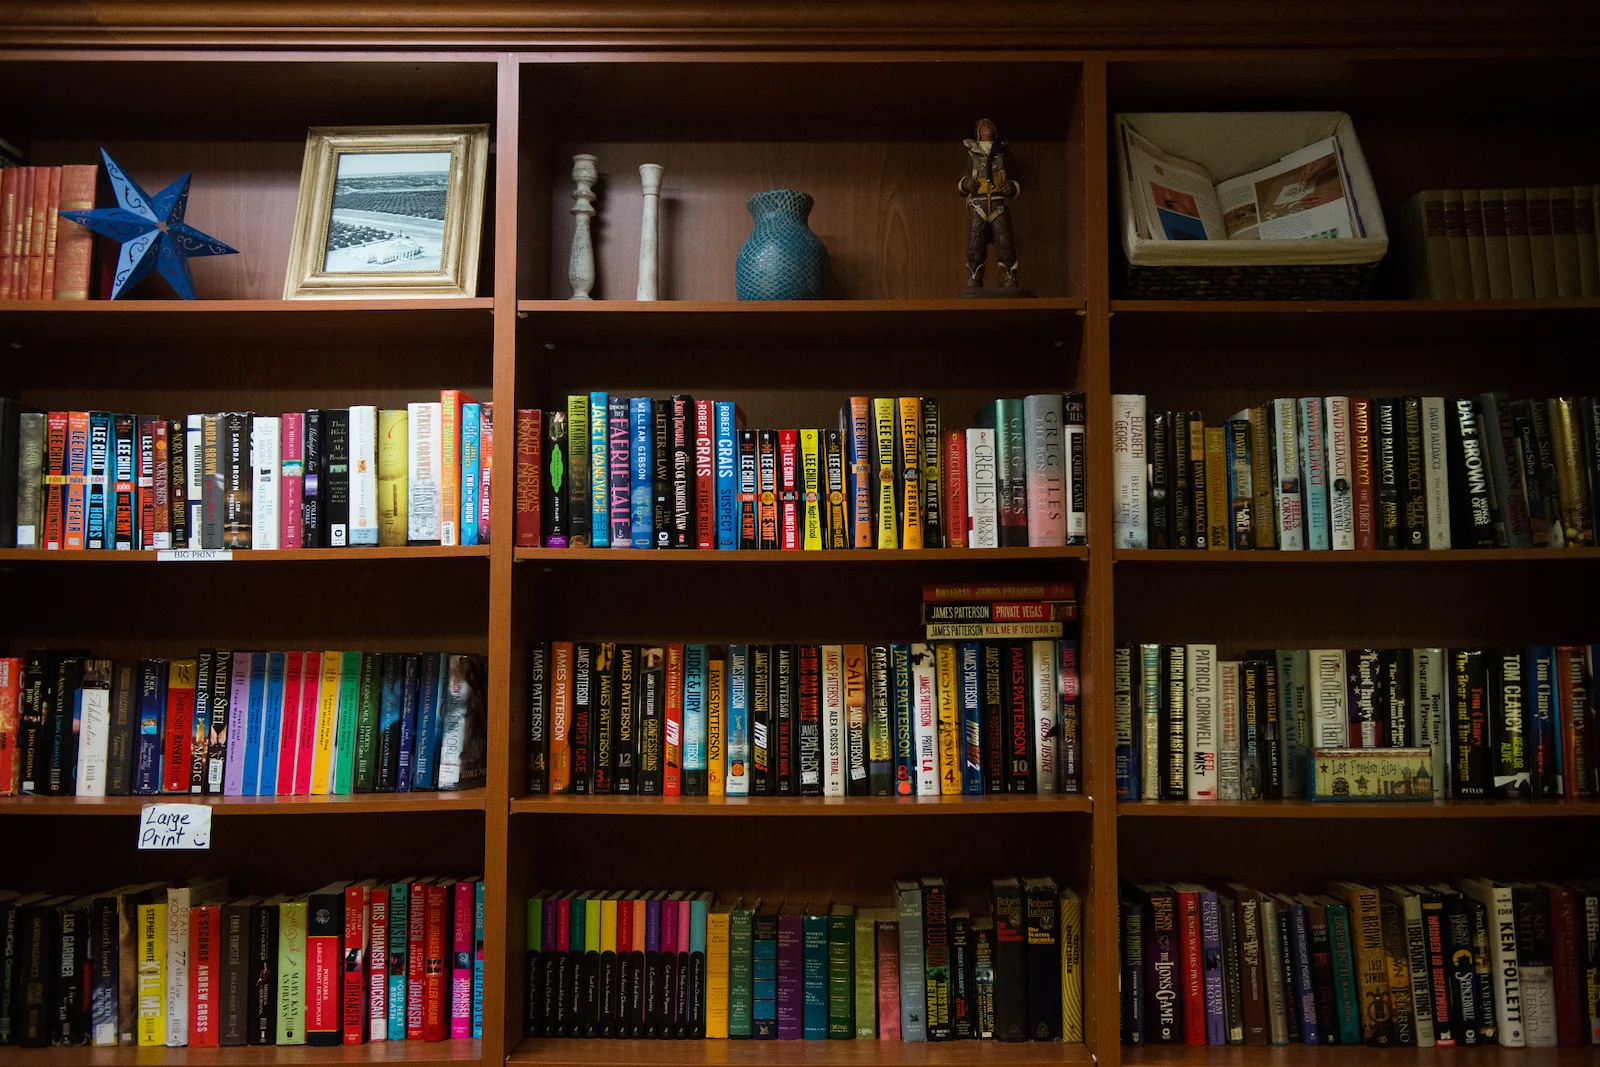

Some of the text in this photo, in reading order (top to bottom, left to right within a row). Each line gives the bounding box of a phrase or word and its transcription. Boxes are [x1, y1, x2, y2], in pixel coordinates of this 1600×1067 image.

[50, 430, 63, 470] LEE CHILD
[71, 431, 84, 471] LEE CHILD
[92, 427, 105, 469] LEE CHILD
[443, 396, 454, 468] JANET EVANOVICH
[697, 404, 710, 476] ROBERT CRAIS
[719, 406, 732, 477] ROBERT CRAIS
[856, 417, 867, 459] LEE CHILD
[880, 420, 892, 465] LEE CHILD
[905, 419, 916, 464] LEE CHILD
[1115, 420, 1128, 452] GEORGE
[1131, 417, 1143, 459] ELIZABETH
[1307, 401, 1322, 485] DAVID BALDACCI
[1333, 401, 1346, 476] DAVID BALDACCI
[1355, 402, 1369, 485] DAVID BALDACCI
[1380, 405, 1394, 484] DAVID BALDACCI
[1457, 401, 1486, 495] DALE BROWN
[117, 439, 130, 480] LEE CHILD
[592, 403, 606, 513] JANET EVANOVICH
[742, 455, 754, 492] LEE CHILD
[762, 454, 773, 490] LEE CHILD
[829, 454, 841, 490] LEE CHILD
[1045, 412, 1061, 520] GREG ILES
[156, 462, 167, 505] NORA ROBERTS
[927, 483, 938, 524] MAKE ME
[50, 486, 62, 540] WORTH DYING FOR
[69, 498, 82, 531] AFFAIR
[721, 489, 731, 532] SUSPECT
[1312, 491, 1324, 529] THE HIT
[1333, 497, 1343, 533] MAXWELL
[1381, 501, 1391, 528] JUSTICE
[1481, 498, 1491, 524] WINGS
[26, 689, 34, 704] JURY
[197, 654, 211, 715] DANIELLE STEEL
[213, 651, 230, 726] DANIELLE STEEL
[530, 649, 543, 741] JAMES PATTERSON
[554, 649, 566, 740] JAMES PATTERSON
[574, 646, 589, 705] JAMES PATTERSON
[621, 649, 632, 741] JAMES PATTERSON
[780, 649, 790, 718] JAMES PATTERSON
[800, 658, 818, 722] BIG BAD WOLF
[847, 658, 863, 697] SAIL
[964, 647, 977, 708] JAMES PATTERSON
[1115, 648, 1131, 747] PATRICIA CORNWELL
[1196, 650, 1211, 747] PATRICIA CORNWELL
[1503, 654, 1522, 734] TOM CLANCY
[85, 692, 101, 749] Abdication
[599, 675, 610, 766] JAMES PATTERSON
[709, 670, 720, 760] JAMES PATTERSON
[895, 650, 910, 757] JAMES PATTERSON
[1010, 647, 1026, 754] JAMES PATTERSON
[1170, 647, 1184, 789] PATRICIA CORNWELL THE LAST PRECINCT
[26, 729, 36, 778] JOHN GRISHAM
[173, 734, 184, 764] RANSOM
[193, 746, 203, 781] MAGIC
[575, 712, 588, 772] WORST CASE
[1194, 752, 1205, 776] MIST
[1501, 742, 1511, 763] ALIVE
[1117, 755, 1130, 779] dust
[1332, 759, 1347, 775] Let
[142, 827, 185, 846] Print
[146, 808, 190, 831] Large
[180, 907, 188, 936] DEAN
[372, 902, 385, 969] IRIS JOHANSEN
[391, 897, 406, 948] JOHANSEN
[410, 893, 424, 941] JOHANSEN
[927, 894, 948, 966] ROBERT LUDLUM
[1162, 897, 1172, 931] NELSON
[1203, 901, 1211, 942] CASTLE
[1360, 894, 1381, 949] DAN BROWN
[1518, 902, 1534, 953] FOLLETT
[1534, 914, 1545, 940] KEN
[61, 913, 74, 977] LISA GARDNER
[197, 920, 209, 1032] SECONDS ANDREW GROSS
[1407, 927, 1430, 1015] BREAKING THE RING
[1500, 922, 1522, 1023] KEN FOLLETT
[345, 980, 359, 1026] JOHANSEN
[396, 979, 404, 1027] YOUR NEXT
[409, 979, 423, 1027] JOHANSEN
[460, 977, 471, 1018] JOHANSEN
[927, 979, 938, 1027] BETRAYAL
[937, 981, 948, 1023] TRISTAN
[1206, 977, 1214, 1015] FRONT
[1214, 977, 1223, 1015] STORM
